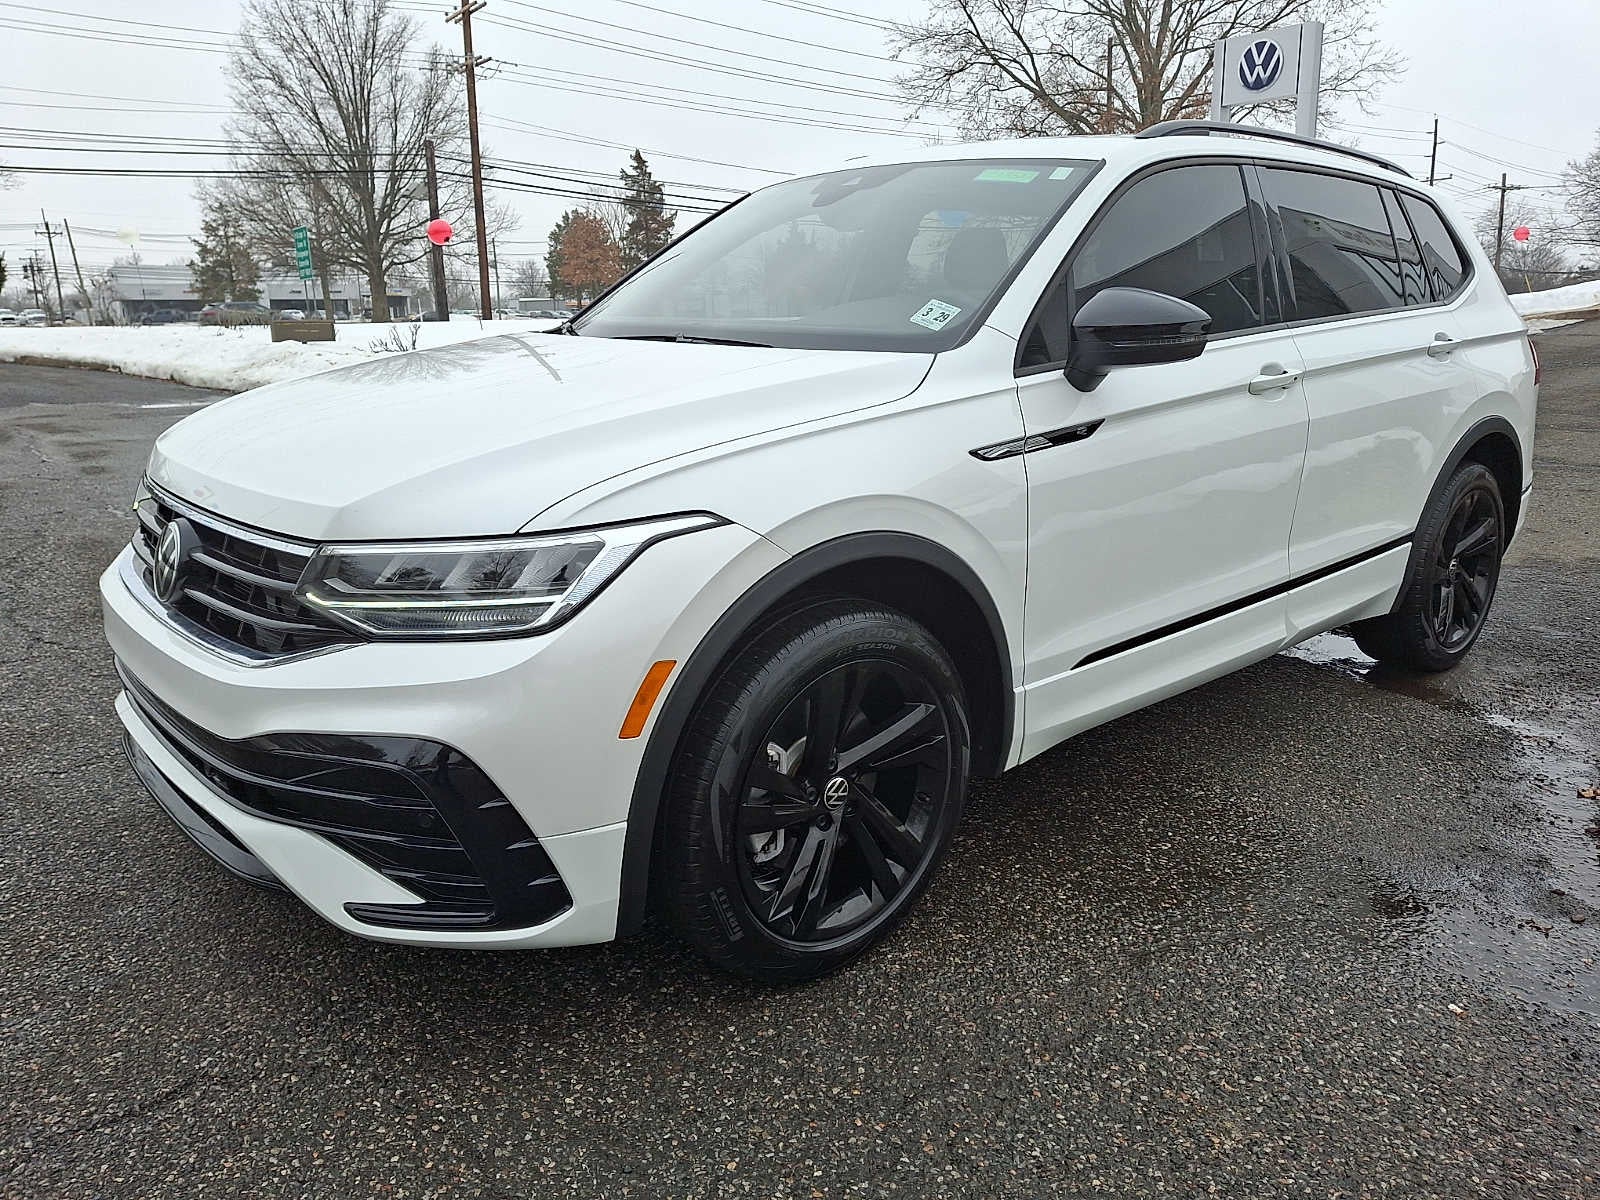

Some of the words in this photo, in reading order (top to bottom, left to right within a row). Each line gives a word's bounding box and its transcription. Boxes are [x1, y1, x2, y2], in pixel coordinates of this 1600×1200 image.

[1240, 40, 1282, 90] VW
[923, 307, 933, 317] 3
[933, 311, 950, 322] 29
